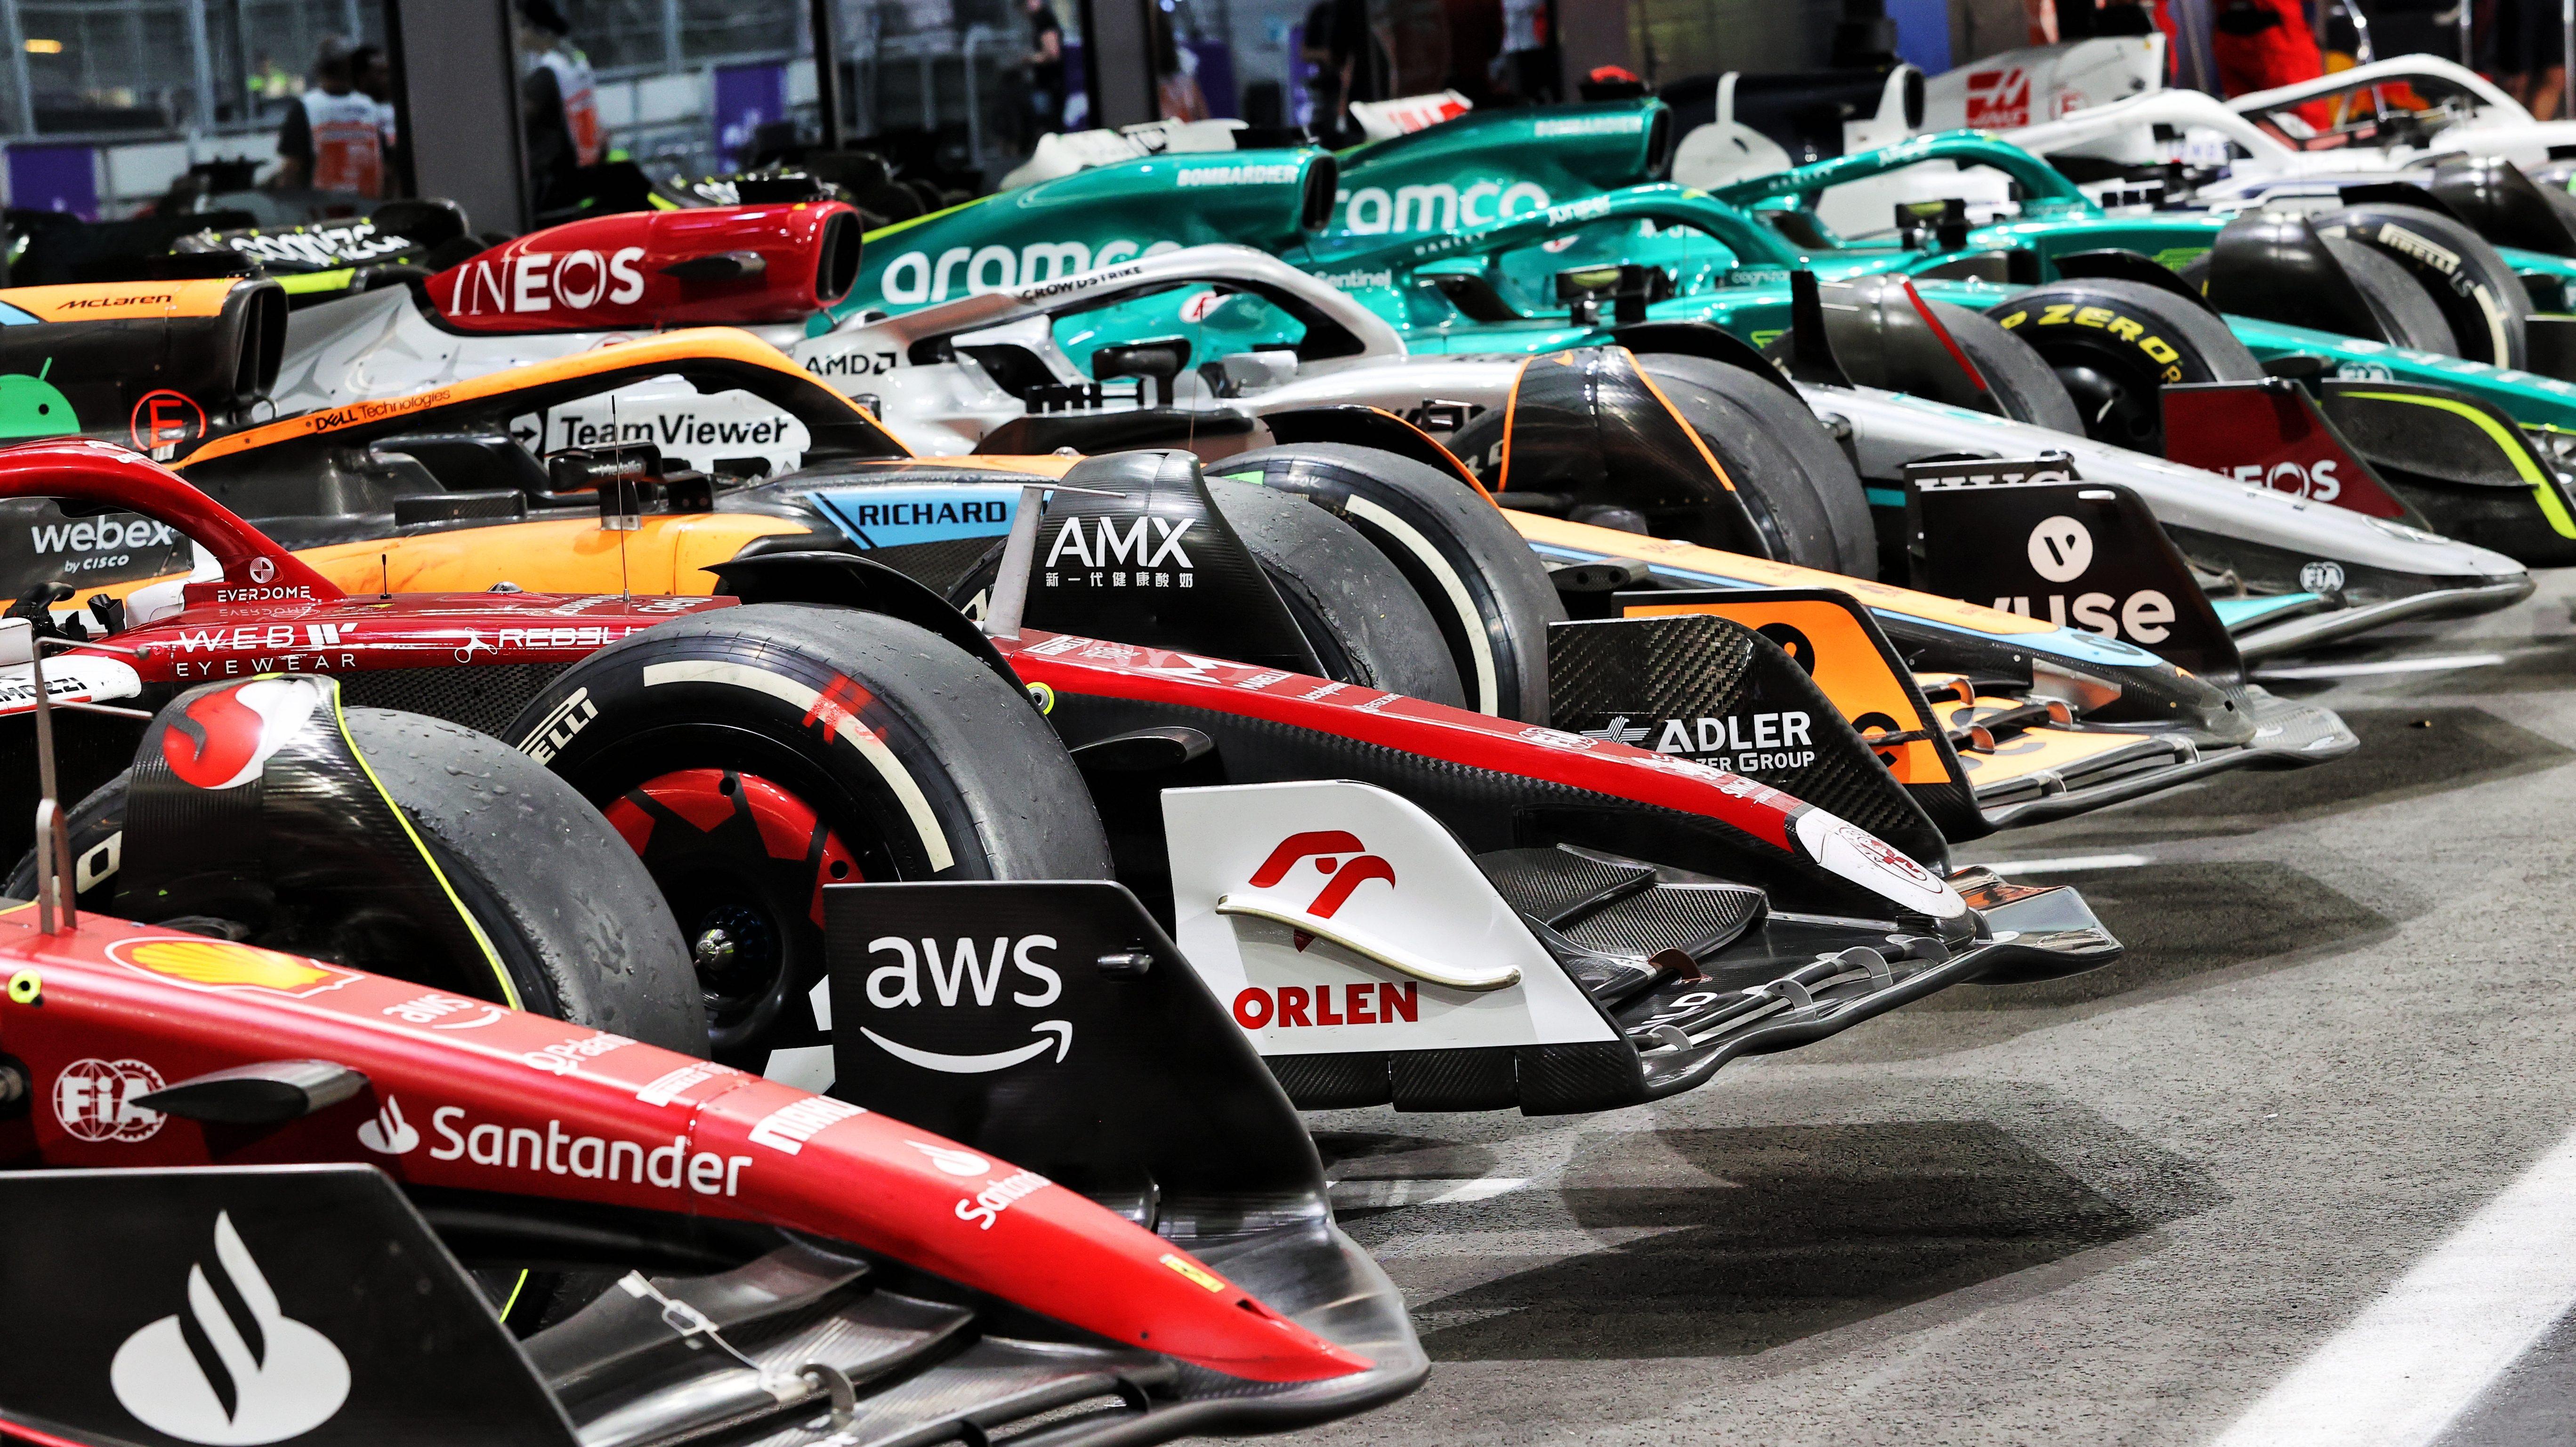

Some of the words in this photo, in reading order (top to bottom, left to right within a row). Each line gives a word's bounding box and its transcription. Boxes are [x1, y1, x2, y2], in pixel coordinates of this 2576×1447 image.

[1177, 164, 1297, 186] BOMBARDIER
[448, 246, 645, 316] INEOS
[57, 294, 172, 310] McLaren
[2038, 304, 2181, 365] ZERO
[806, 354, 868, 376] AMD
[150, 400, 183, 449] E
[315, 409, 358, 431] DELL
[358, 389, 451, 419] Technologies
[561, 414, 789, 446] TeamViewer
[859, 501, 1006, 526] RICHARD
[31, 515, 174, 554] webex
[1045, 516, 1196, 568] AMX
[65, 560, 81, 574] by
[83, 555, 129, 570] CISCO
[218, 586, 311, 603] EVERDOME
[1045, 571, 1194, 589] 新一代健康酸奶
[179, 625, 295, 653] WEB
[1022, 635, 1094, 656] PIRELLI
[177, 653, 356, 676] EYEWEAR
[1233, 670, 1294, 691] MARELLI
[1655, 711, 1812, 753] ADLER
[1739, 751, 1815, 772] GROUP
[865, 934, 1062, 1009] aws
[382, 993, 474, 1024] aws
[1233, 981, 1419, 1030] ORLEN
[430, 1105, 753, 1197] Santander
